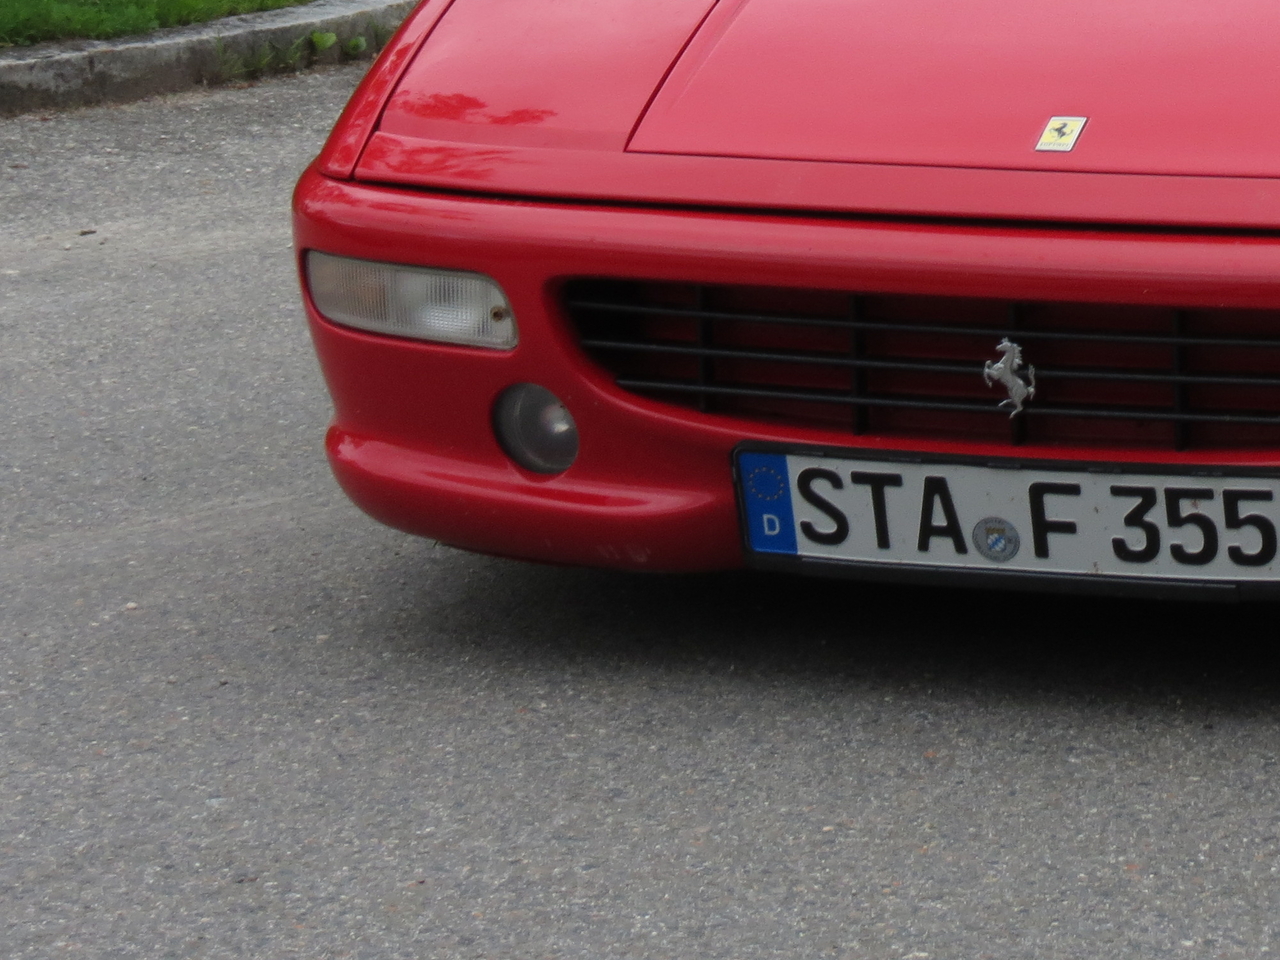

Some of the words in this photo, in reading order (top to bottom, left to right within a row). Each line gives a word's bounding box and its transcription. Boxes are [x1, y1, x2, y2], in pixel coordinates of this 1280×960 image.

[763, 514, 780, 536] D
[797, 467, 968, 555] STA
[1028, 482, 1081, 559] F
[1110, 484, 1278, 568] 355
